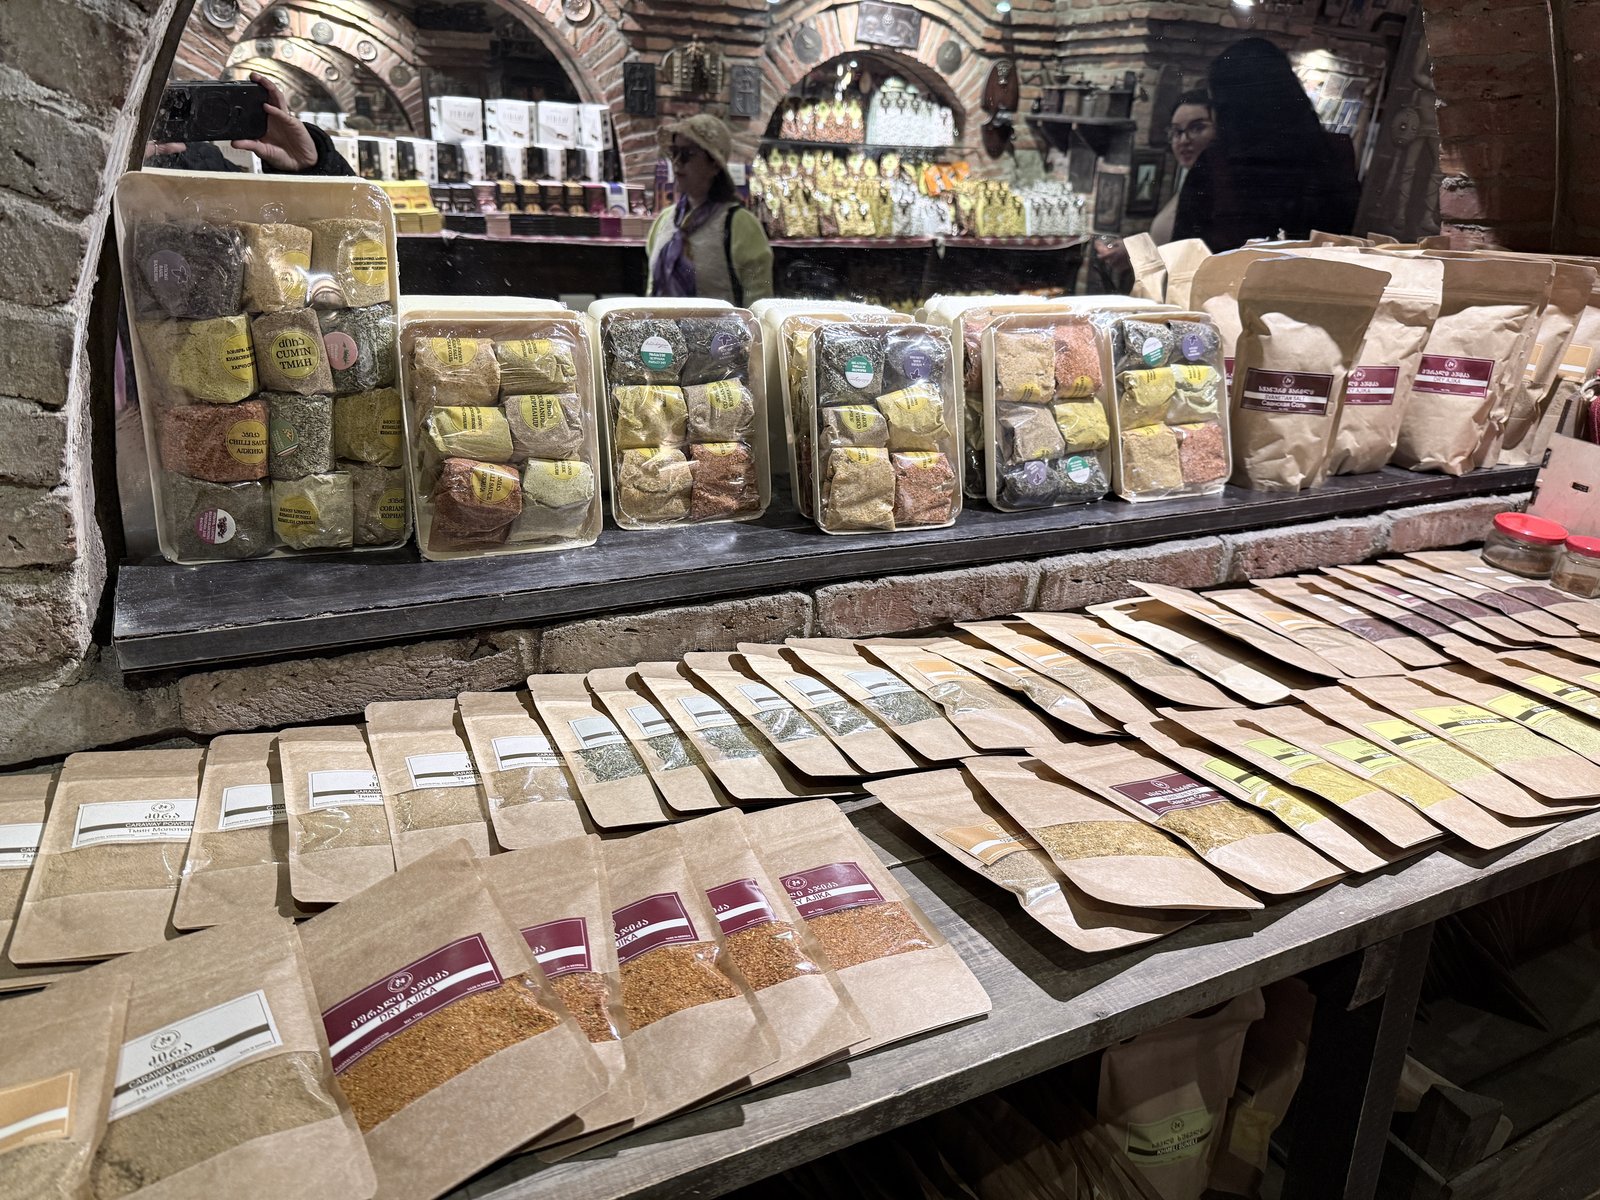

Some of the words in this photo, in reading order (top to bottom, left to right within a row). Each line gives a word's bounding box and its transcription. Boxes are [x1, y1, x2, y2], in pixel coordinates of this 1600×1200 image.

[275, 347, 312, 360] CUMIN
[279, 358, 313, 370] ТМИН
[805, 891, 832, 905] AJIKA
[616, 933, 639, 949] JIKA
[379, 1004, 401, 1023] DRY
[405, 986, 438, 1009] AJIKA
[129, 1063, 174, 1089] CARAWAY
[175, 1046, 217, 1068] POWDER
[135, 1079, 164, 1096] Тмин
[165, 1056, 217, 1083] Молотый
